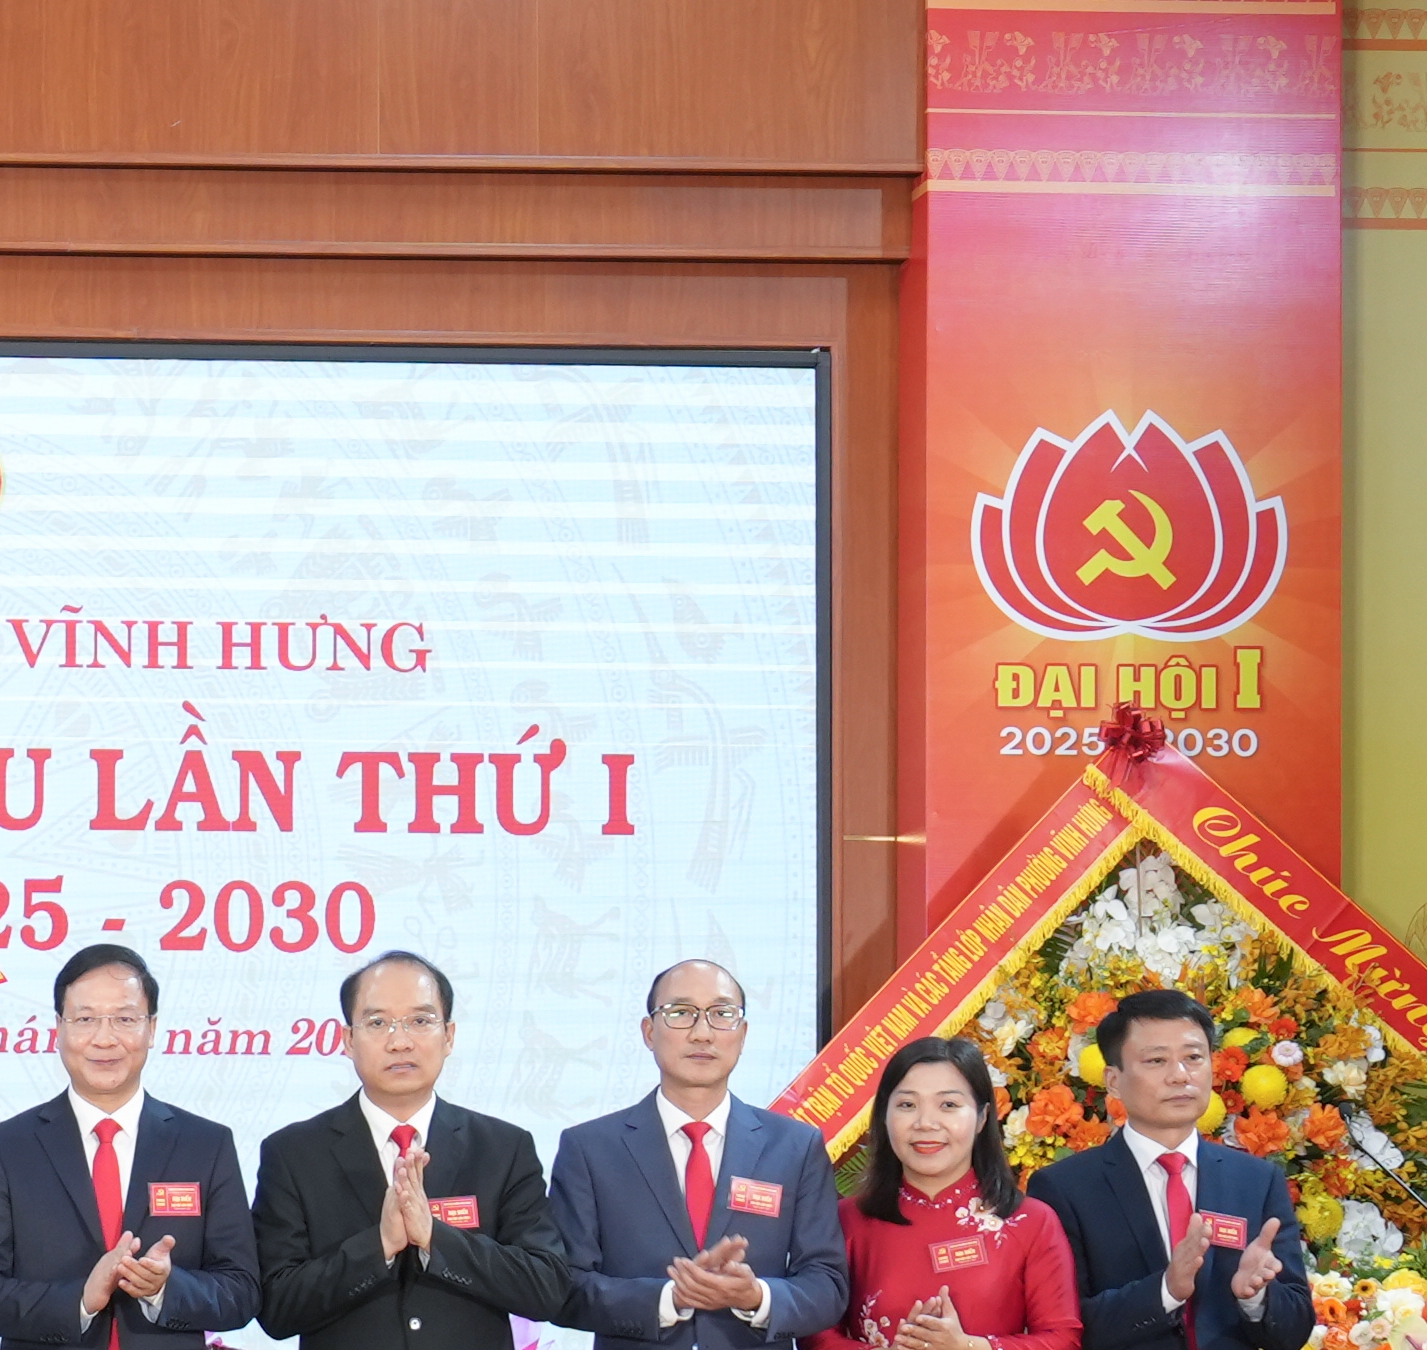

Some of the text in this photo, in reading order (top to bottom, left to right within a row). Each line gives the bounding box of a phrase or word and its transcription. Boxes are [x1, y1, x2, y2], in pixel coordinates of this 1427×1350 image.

[7, 604, 194, 670] VĨNH
[215, 613, 433, 674] HƯNG
[994, 648, 1262, 720] ĐẠI HỘI I
[998, 725, 1259, 758] 2025 030
[88, 700, 302, 833] LẦN
[335, 723, 567, 836] THỨ
[601, 753, 635, 836] I
[1192, 806, 1310, 920] Chúc
[159, 879, 376, 953] 2030
[900, 986, 933, 1019] VÀ
[914, 971, 950, 1005] CÁC
[162, 1016, 273, 1056] năm
[284, 1017, 348, 1057] 20
[880, 1003, 920, 1041] NAM
[837, 1042, 880, 1087] QUỐC
